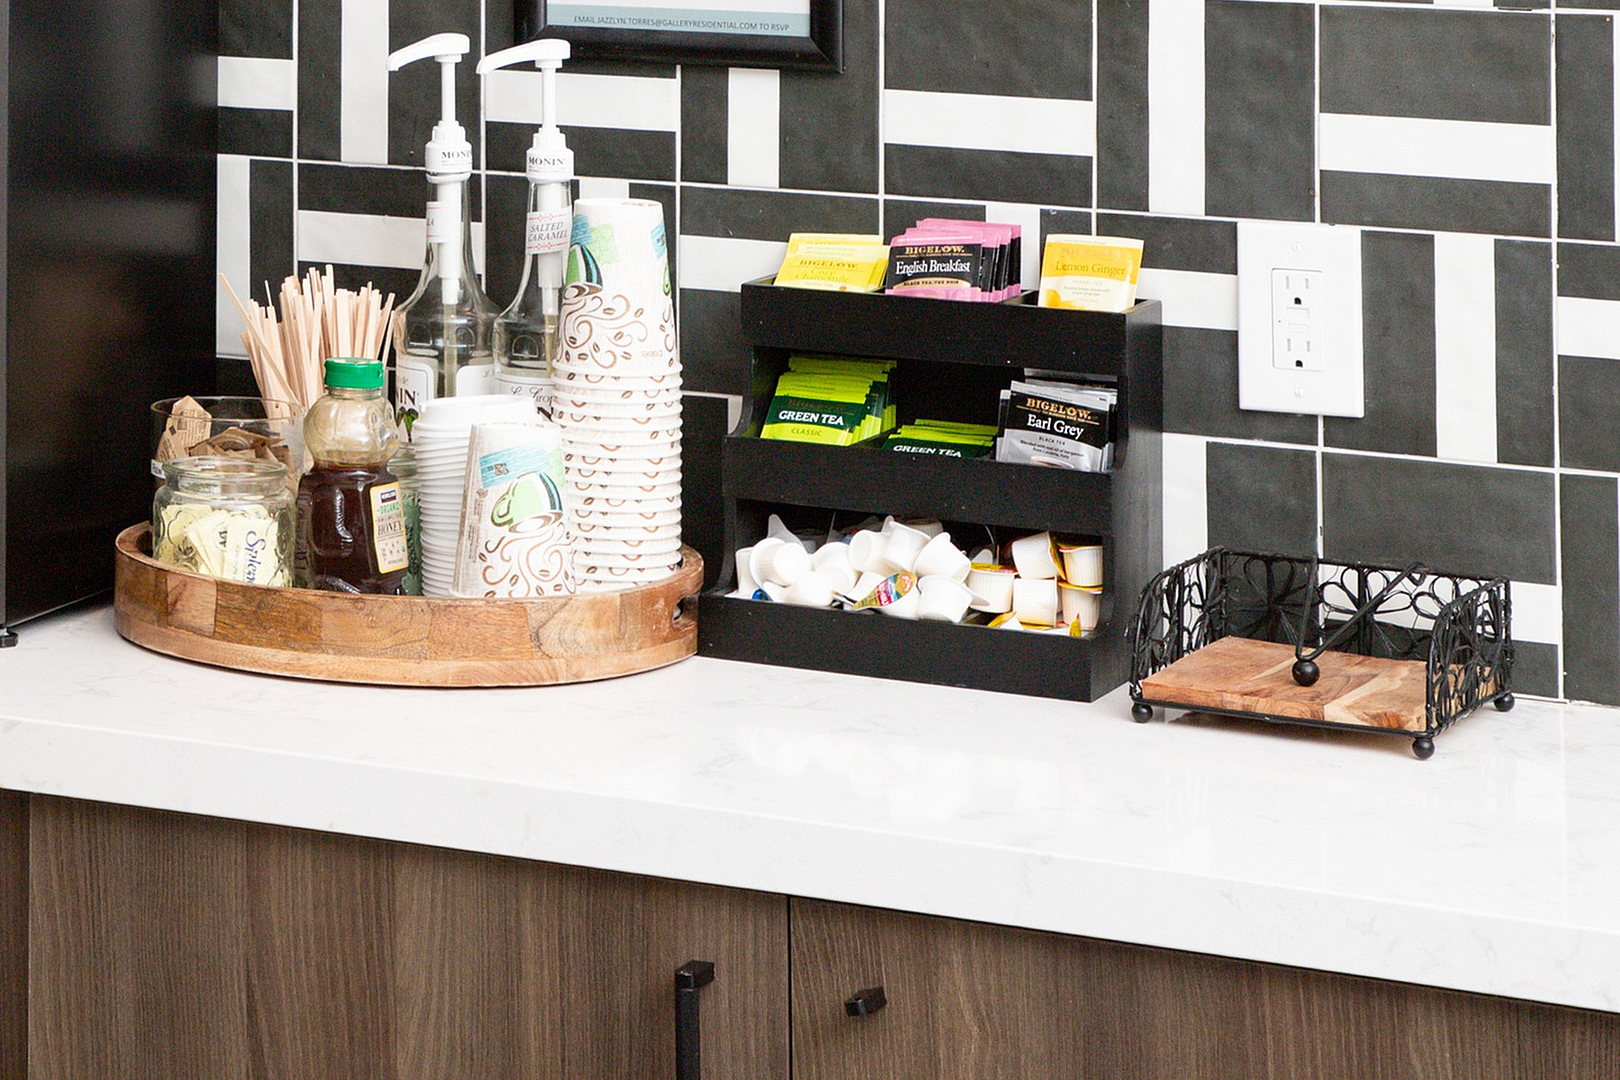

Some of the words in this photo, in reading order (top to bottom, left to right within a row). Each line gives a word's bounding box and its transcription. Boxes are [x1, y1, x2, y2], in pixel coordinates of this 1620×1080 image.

[573, 15, 596, 25] EMAIL
[759, 23, 770, 31] TO
[770, 23, 790, 32] RSVP
[528, 156, 564, 166] MONIN
[530, 221, 564, 233] SALTED
[527, 230, 568, 242] CARAMEL
[895, 259, 928, 276] English
[929, 258, 971, 273] Breakfast
[1055, 261, 1089, 273] Lemon
[1091, 263, 1127, 277] Ginger
[795, 273, 850, 283] Chamomile
[778, 410, 819, 422] GREEN
[820, 413, 844, 426] TEA
[791, 427, 823, 437] CLASSIC
[1026, 413, 1052, 431] Earl
[1053, 420, 1085, 440] Grey
[893, 445, 937, 454] GREEN
[938, 448, 962, 458] TEA
[377, 520, 402, 536] HONEY
[243, 530, 267, 584] Splen
